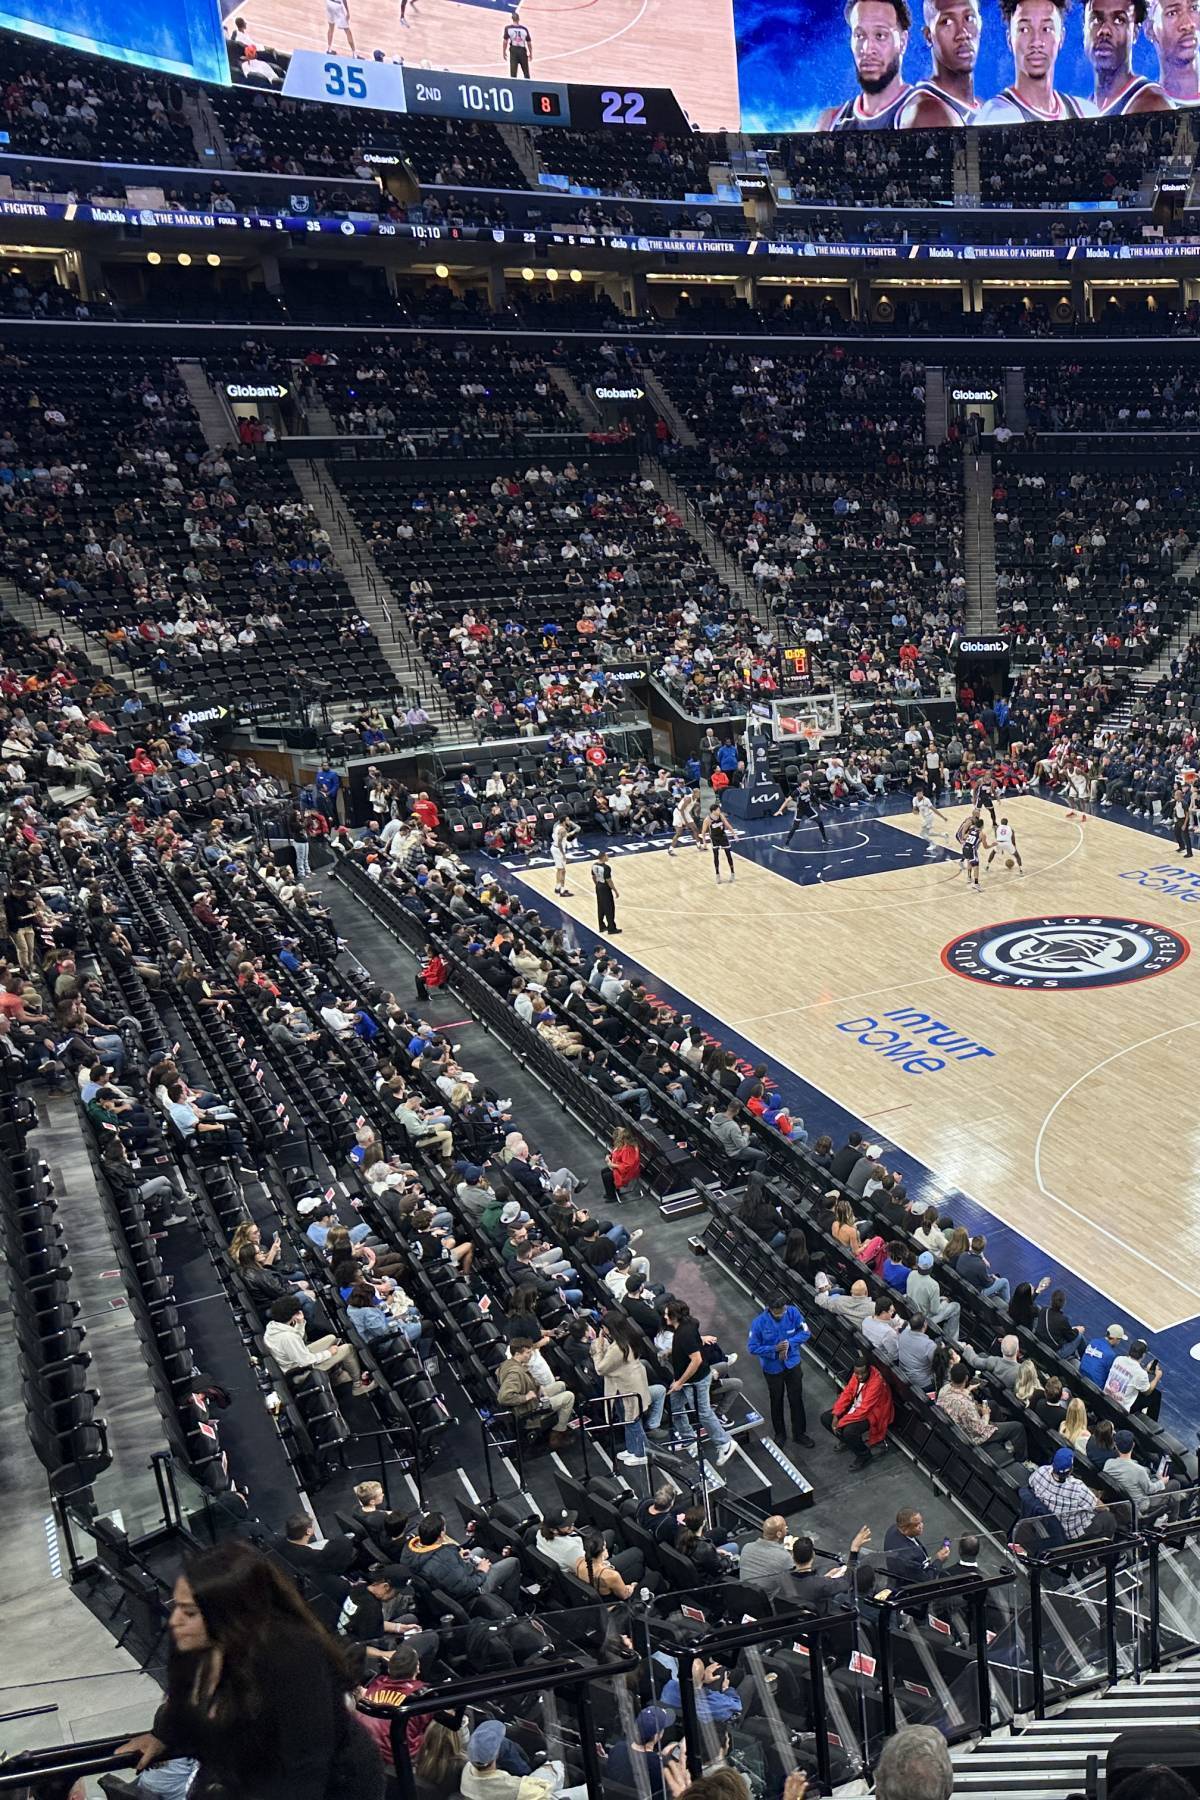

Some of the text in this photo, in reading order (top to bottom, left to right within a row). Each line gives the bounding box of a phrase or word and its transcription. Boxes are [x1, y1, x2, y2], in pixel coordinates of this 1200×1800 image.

[323, 62, 368, 102] 35
[416, 83, 551, 114] 2ND 10:10 8
[600, 91, 647, 126] 22
[4, 202, 47, 218] FIGHTER
[154, 213, 174, 225] THE
[175, 214, 202, 227] MARK
[243, 217, 459, 239] 2 5 35 2ND 10:10 8
[523, 232, 536, 243] 22
[568, 235, 575, 245] 5
[610, 237, 627, 249] delo
[649, 240, 663, 251] THE
[663, 240, 685, 251] MARK
[704, 243, 734, 253] FIGHTER
[768, 243, 794, 255] Modelo
[815, 246, 828, 255] THE
[829, 246, 850, 256] MARK
[868, 248, 897, 257] FIGHTER
[929, 247, 953, 258] Modelo
[974, 248, 988, 258] THE
[989, 249, 1008, 258] MARK
[1026, 249, 1055, 259] FIGHTER
[1086, 247, 1110, 258] Modelo
[1130, 247, 1143, 257] THE
[1144, 247, 1163, 257] MARK
[226, 384, 280, 397] Globant
[595, 387, 637, 398] Globant
[952, 390, 991, 400] Globant
[960, 642, 1001, 652] Globant
[611, 671, 641, 681] lobant
[170, 708, 220, 722] obant
[566, 829, 746, 861] CLIPPE
[1042, 917, 1178, 971] LOS ANGELES
[954, 941, 1059, 988] CLIPPERS
